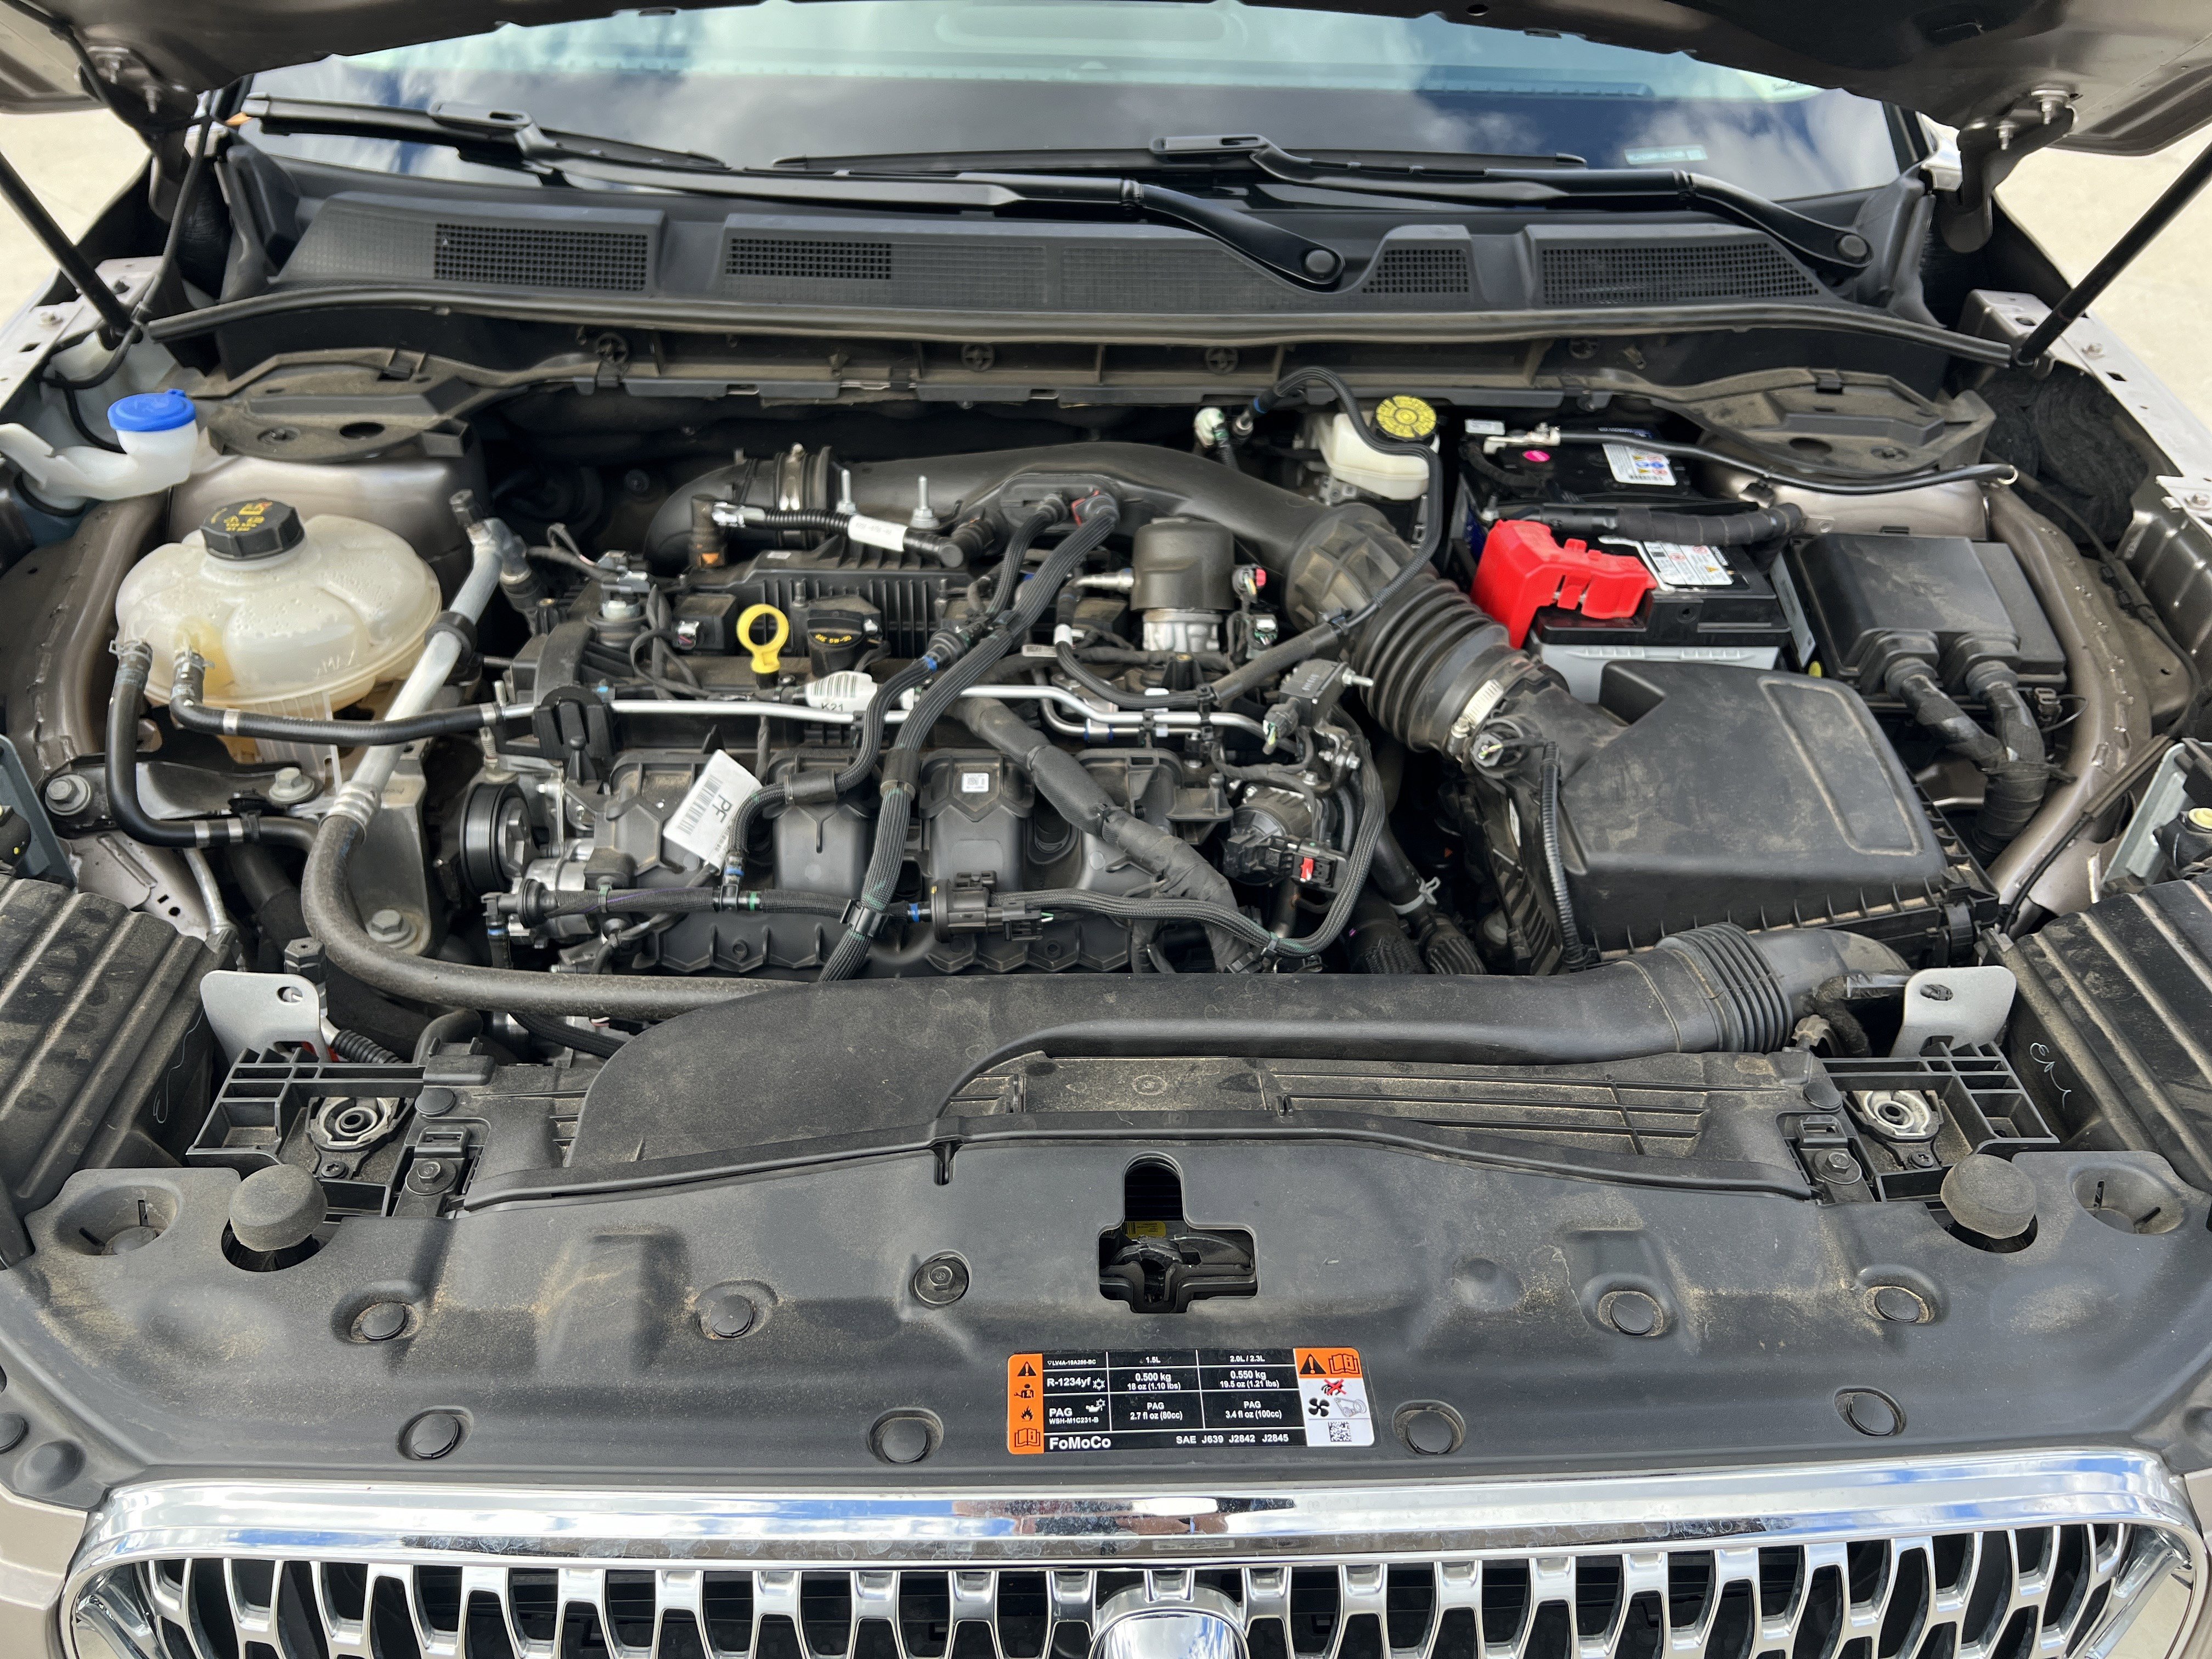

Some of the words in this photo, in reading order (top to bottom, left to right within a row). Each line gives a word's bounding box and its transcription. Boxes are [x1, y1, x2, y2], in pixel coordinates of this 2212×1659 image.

[1135, 1372, 1159, 1382] 0.500
[1160, 1372, 1172, 1383] kg
[1230, 1370, 1254, 1380] 0.550
[1255, 1370, 1267, 1380] kg
[1047, 1376, 1091, 1388] R-1234yf
[1127, 1383, 1137, 1391] 18
[1148, 1382, 1166, 1391] (1.10
[1166, 1381, 1181, 1391] lbs)
[1220, 1380, 1235, 1389] 19.5
[1246, 1380, 1264, 1389] (1.21
[1265, 1379, 1280, 1389] lbs)
[1147, 1402, 1165, 1410] PAG
[1243, 1401, 1261, 1409] PAG
[1049, 1407, 1073, 1418] PAG
[1130, 1412, 1142, 1421] 2.7
[1142, 1411, 1148, 1420] fl
[1160, 1410, 1183, 1421] (80cc)
[1225, 1410, 1237, 1419] 3.4
[1238, 1410, 1244, 1419] fl
[1255, 1409, 1282, 1420] (100cc)
[1048, 1435, 1112, 1451] FoMoCo
[1176, 1435, 1197, 1444] SAE
[1201, 1435, 1224, 1444] J639
[1228, 1434, 1256, 1443] J2842
[1262, 1434, 1289, 1443] J2845
